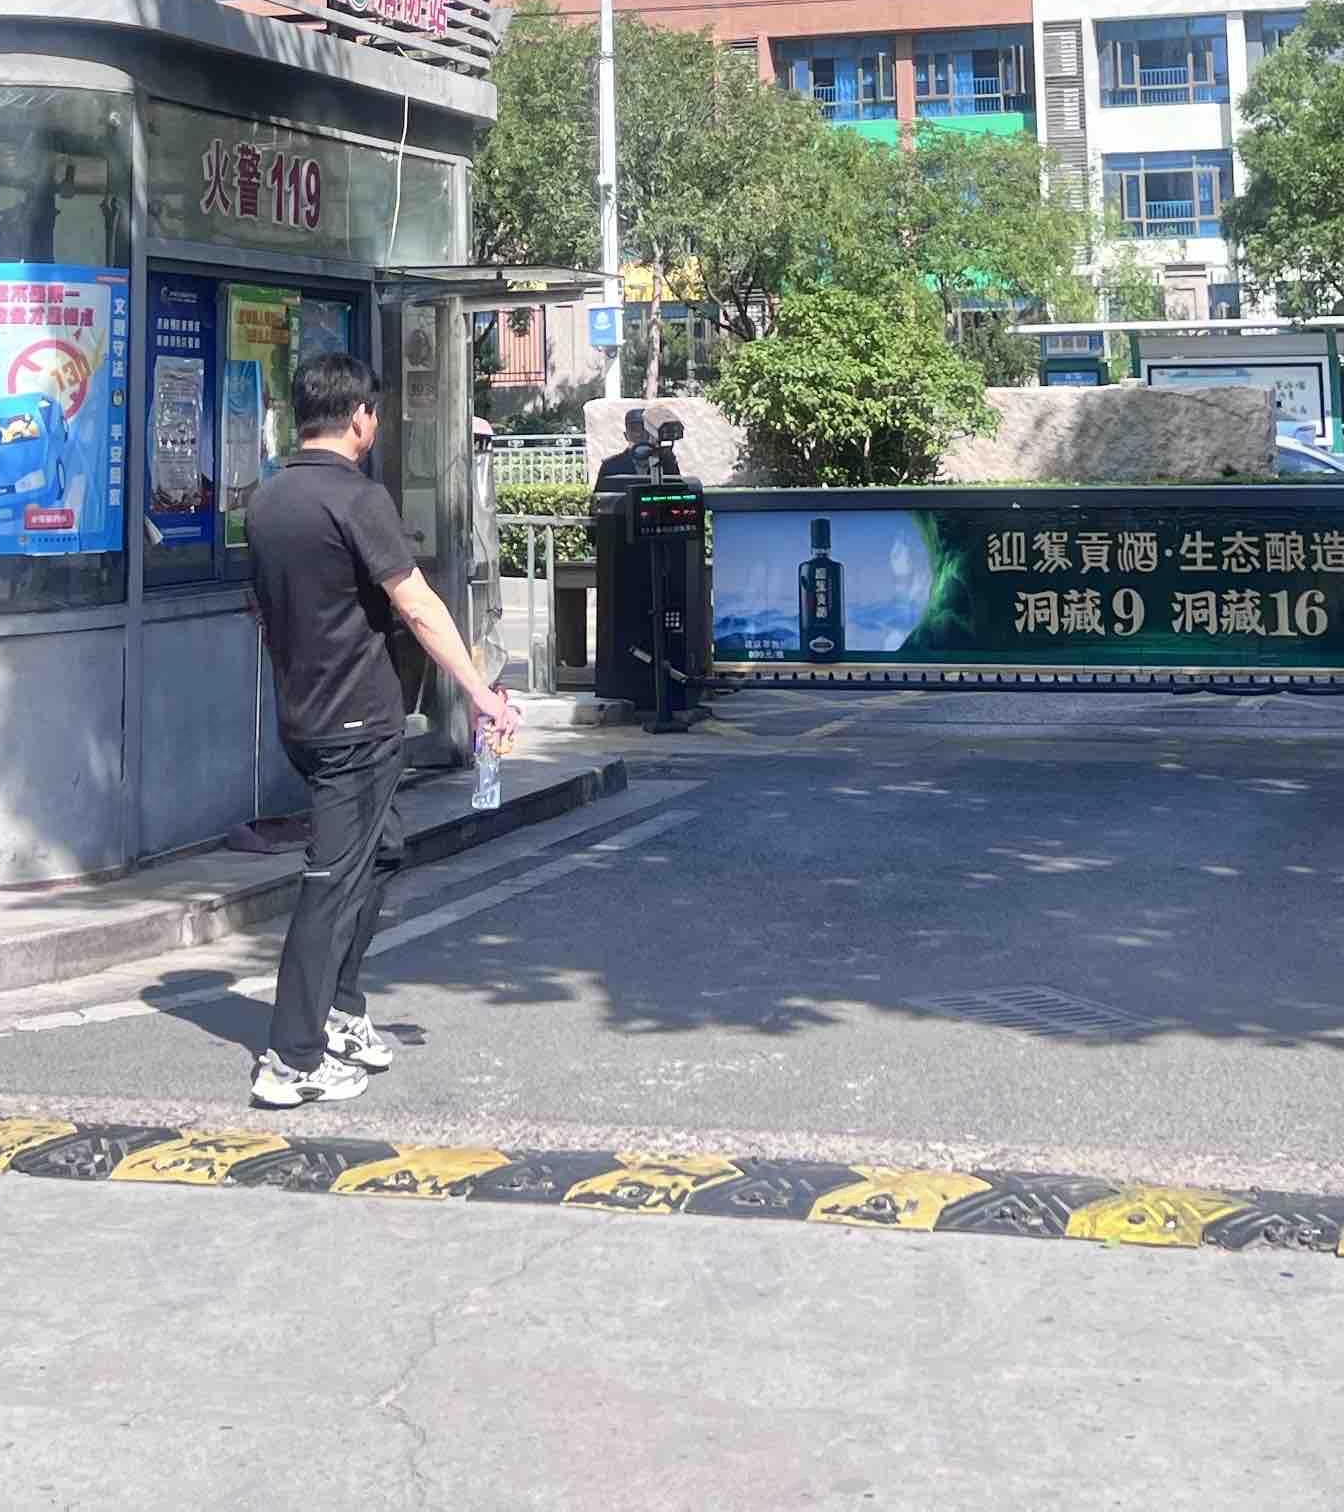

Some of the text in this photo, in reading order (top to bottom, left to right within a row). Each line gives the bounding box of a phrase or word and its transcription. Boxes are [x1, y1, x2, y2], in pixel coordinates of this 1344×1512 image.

[200, 138, 320, 231] 火警119
[1014, 587, 1329, 637] 洞藏9 洞藏16
